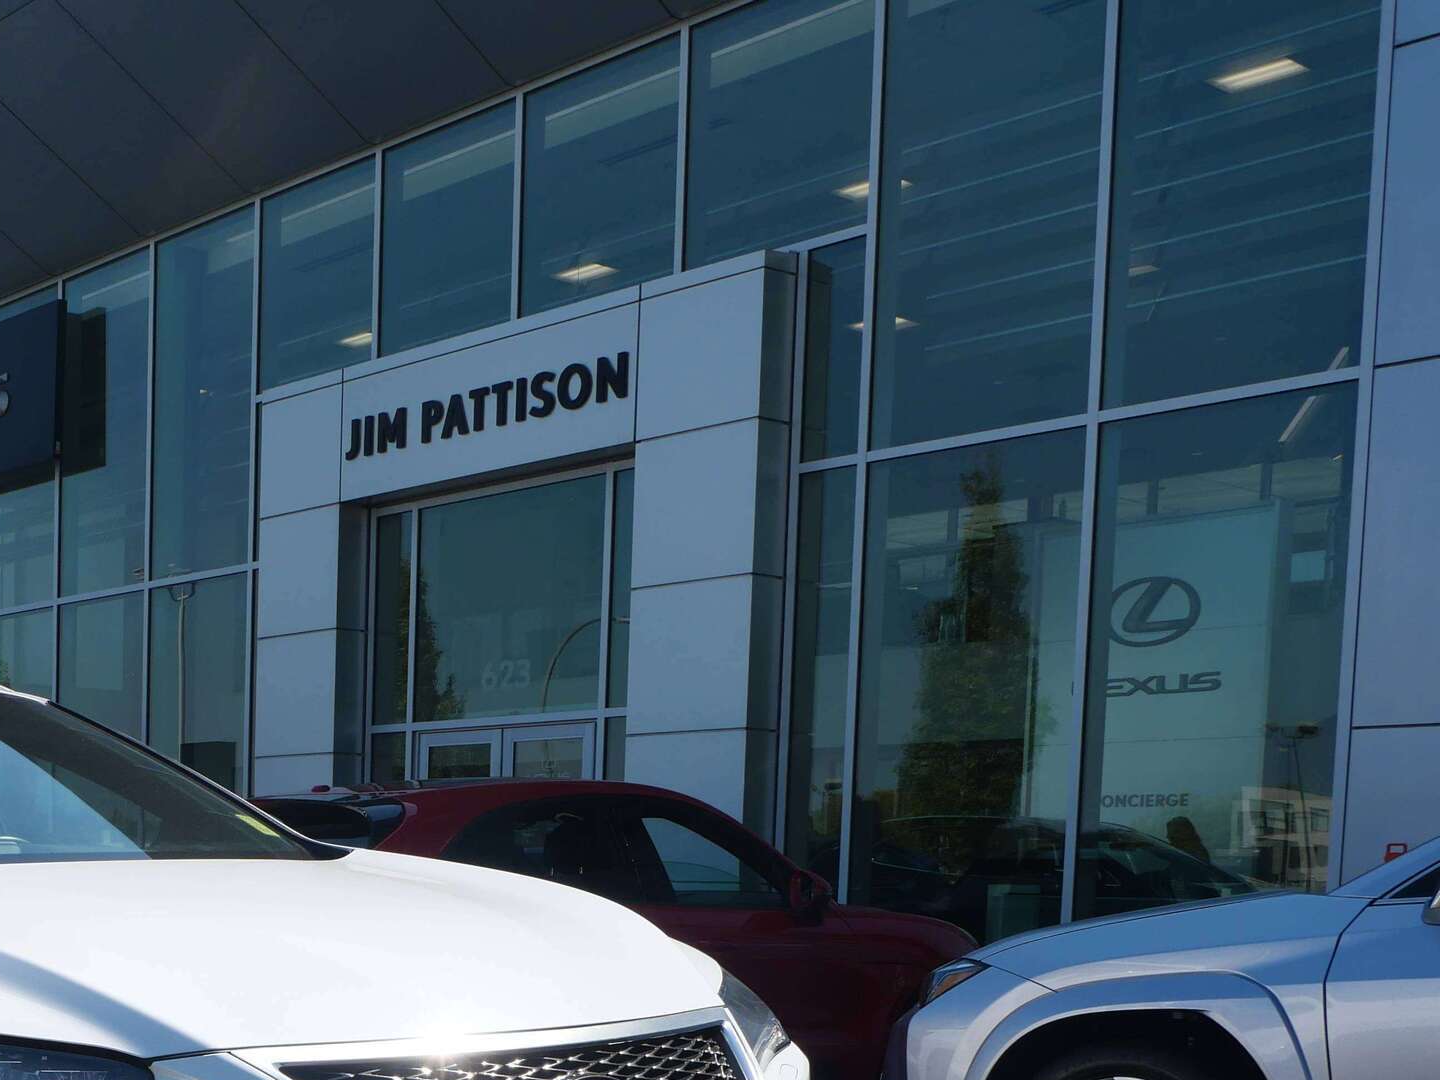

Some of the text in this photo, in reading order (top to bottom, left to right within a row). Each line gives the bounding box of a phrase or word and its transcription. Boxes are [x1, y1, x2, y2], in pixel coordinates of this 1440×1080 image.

[345, 351, 630, 461] JIM PATTISON
[480, 657, 532, 690] 623
[1072, 670, 1222, 698] EXUS
[1101, 793, 1190, 808] ONCIERGE
